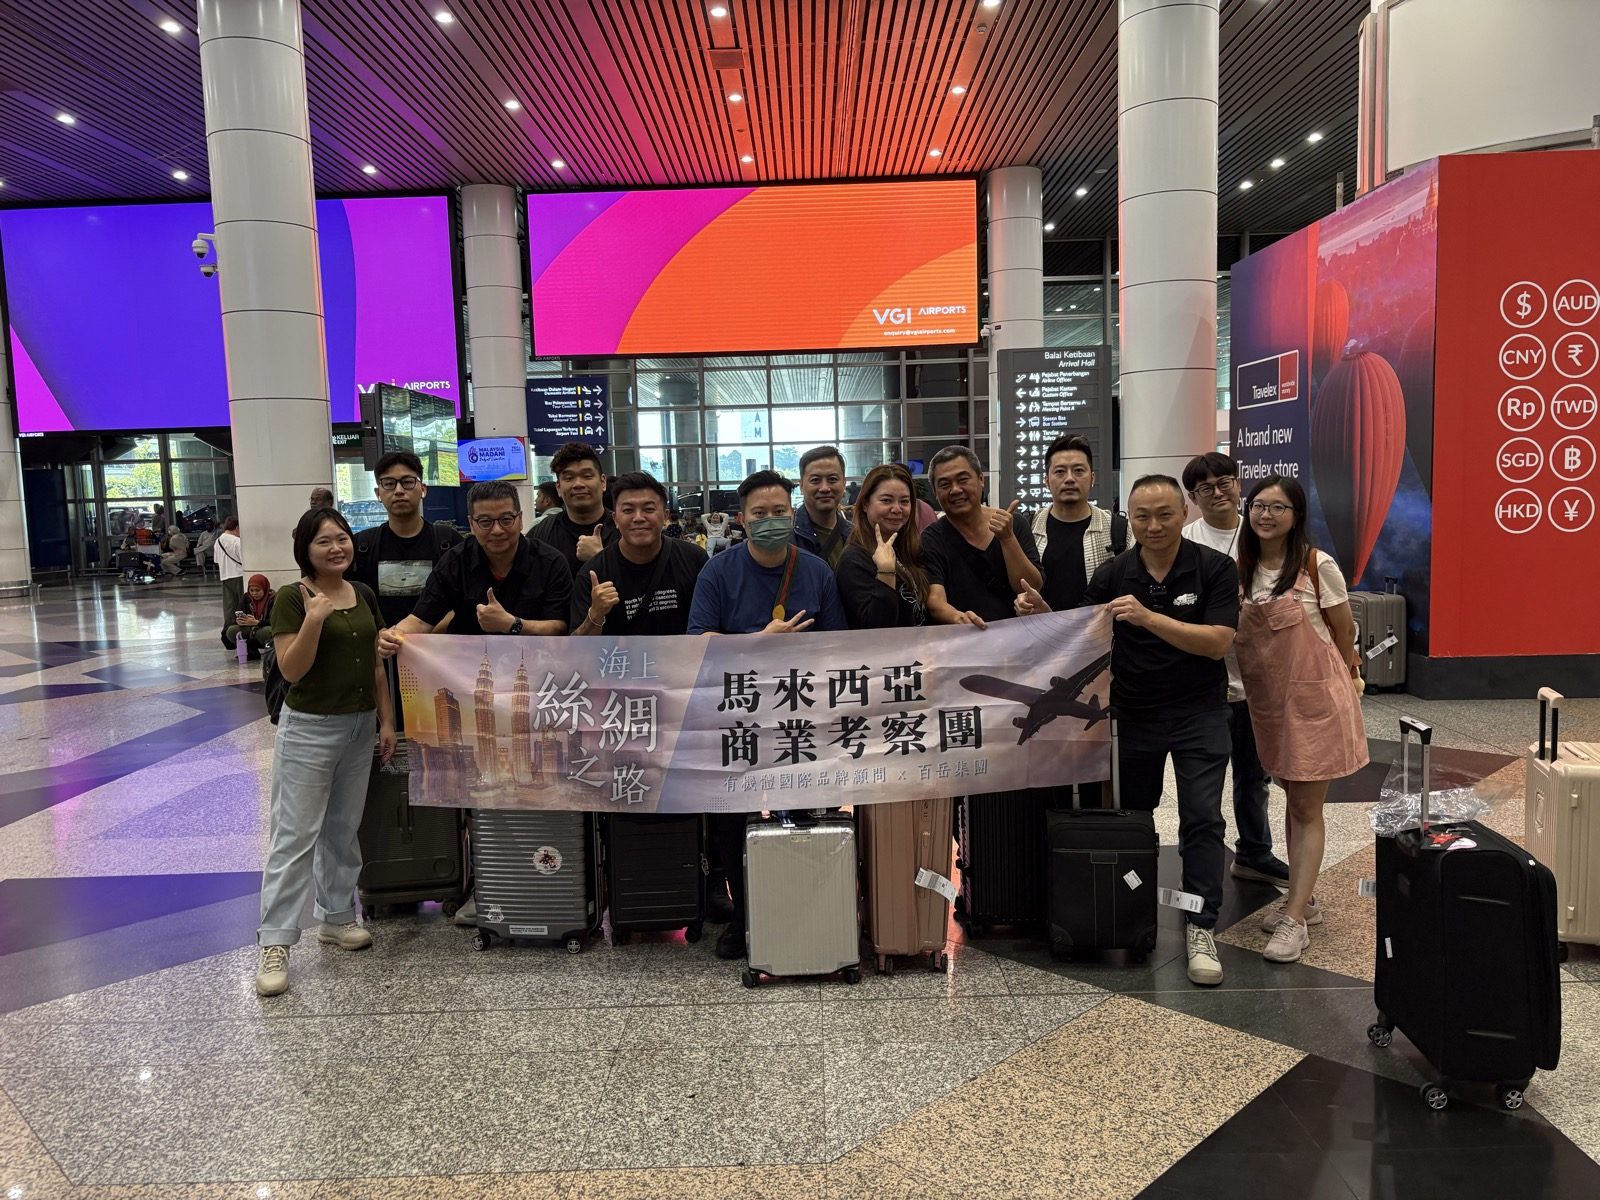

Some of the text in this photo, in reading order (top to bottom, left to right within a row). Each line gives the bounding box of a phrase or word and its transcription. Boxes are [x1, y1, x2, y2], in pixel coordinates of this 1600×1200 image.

[1557, 295, 1597, 311] AUD
[872, 305, 966, 325] VGI AIRPORTS
[1045, 350, 1096, 359] Balai Ketibaan
[1058, 360, 1080, 368] Arrival
[1502, 348, 1542, 365] CNY
[403, 380, 451, 391] AIRPORTS
[1252, 382, 1278, 400] Travelex
[1507, 397, 1536, 420] Rp
[1554, 399, 1595, 414] TWD
[1237, 424, 1293, 447] A brand new
[1236, 458, 1299, 479] Travelex store
[1501, 452, 1539, 468] SGD
[1499, 503, 1539, 518] HKD
[599, 646, 660, 680] 海上
[717, 660, 927, 713] 馬來西亞
[533, 671, 658, 753] 絲綢
[718, 705, 983, 767] 商業考察團
[567, 747, 651, 805] 之路
[918, 759, 988, 781] 百岳集團
